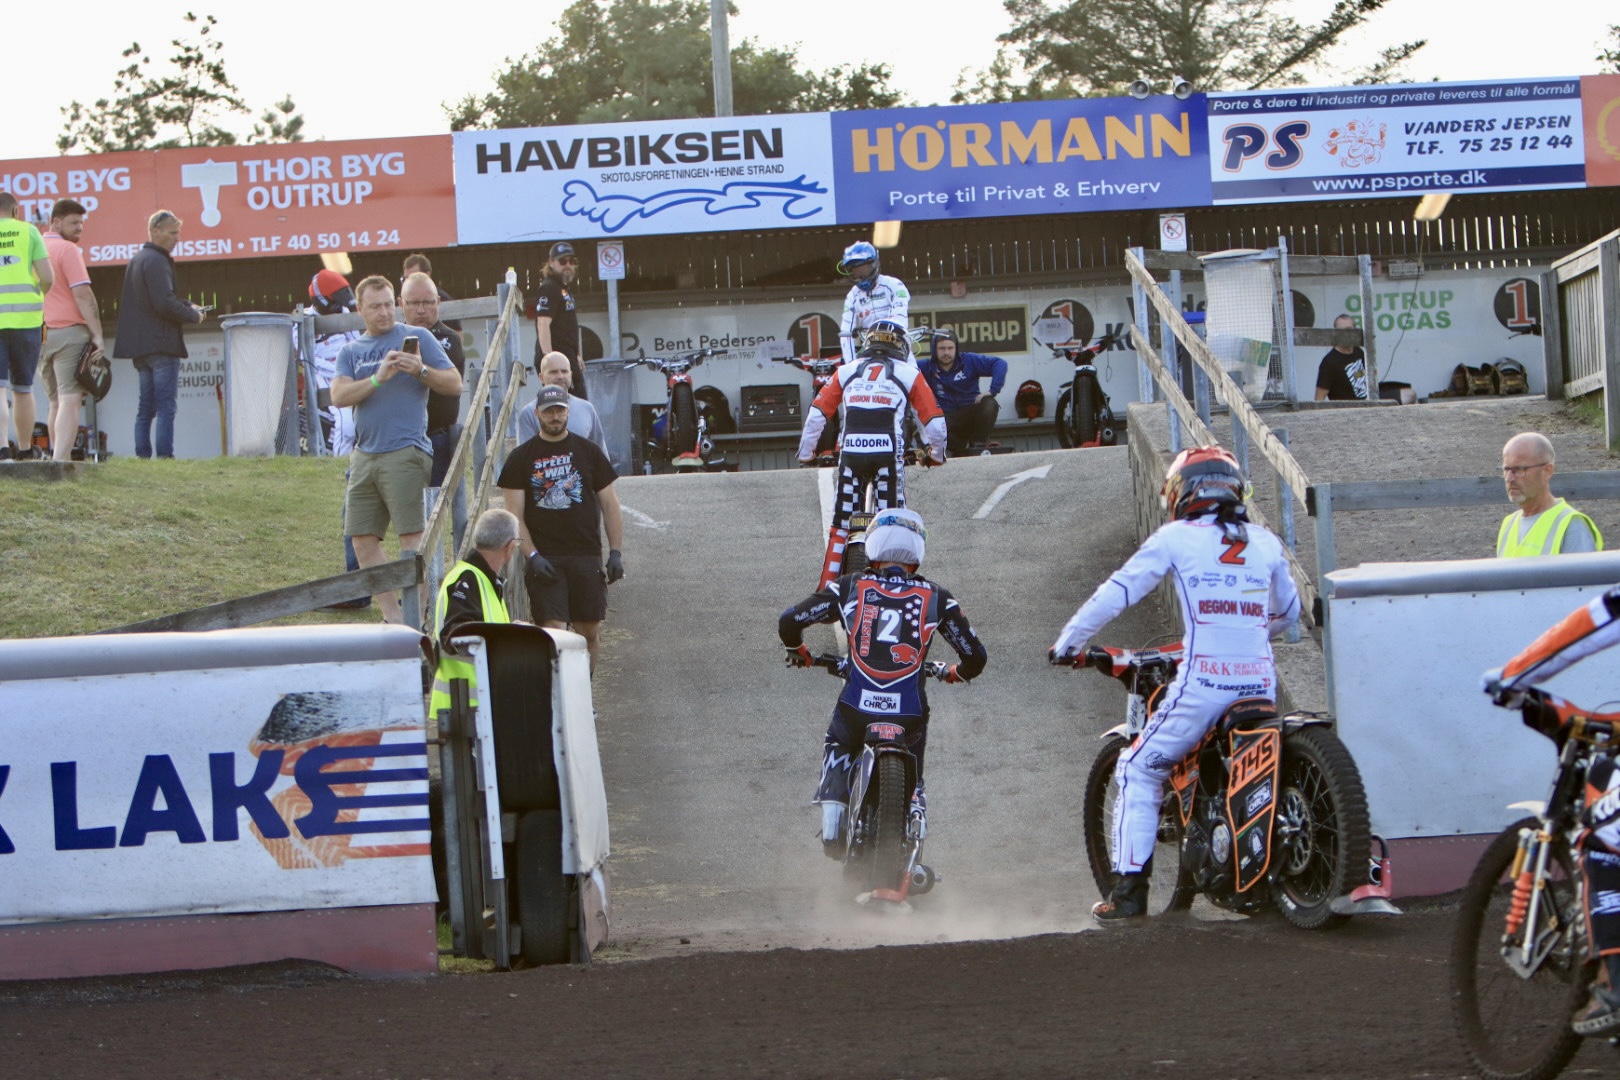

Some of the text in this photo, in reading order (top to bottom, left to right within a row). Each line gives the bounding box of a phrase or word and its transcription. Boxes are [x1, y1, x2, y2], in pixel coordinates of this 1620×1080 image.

[1213, 83, 1575, 110] Porte & døre til industri og private leveres til alle formål
[1404, 115, 1572, 136] V/ANDERS JEPSEN
[476, 127, 784, 174] HAVBIKSEN
[851, 112, 1191, 173] HÖRMANN
[1221, 120, 1311, 173] PS
[1406, 135, 1574, 155] TLF. 75 25 12 44
[67, 167, 131, 193] BYG
[242, 152, 406, 183] THOR BYG
[714, 165, 745, 177] HENNE
[747, 164, 785, 176] STRAND
[1312, 170, 1487, 191] www.psporte.dk
[246, 181, 373, 211] OUTRUP
[889, 179, 1161, 206] Porte til Privat & Erhverv
[90, 244, 146, 263] SØRE
[250, 229, 401, 254] TLF 40 50 14 24
[1505, 279, 1537, 327] 1
[654, 337, 694, 351] Bent
[799, 315, 822, 359] 1
[739, 351, 756, 360] 1967
[1218, 536, 1250, 566] 2
[1198, 599, 1238, 615] REGION
[878, 609, 901, 642] 2
[863, 699, 897, 711] CHROM
